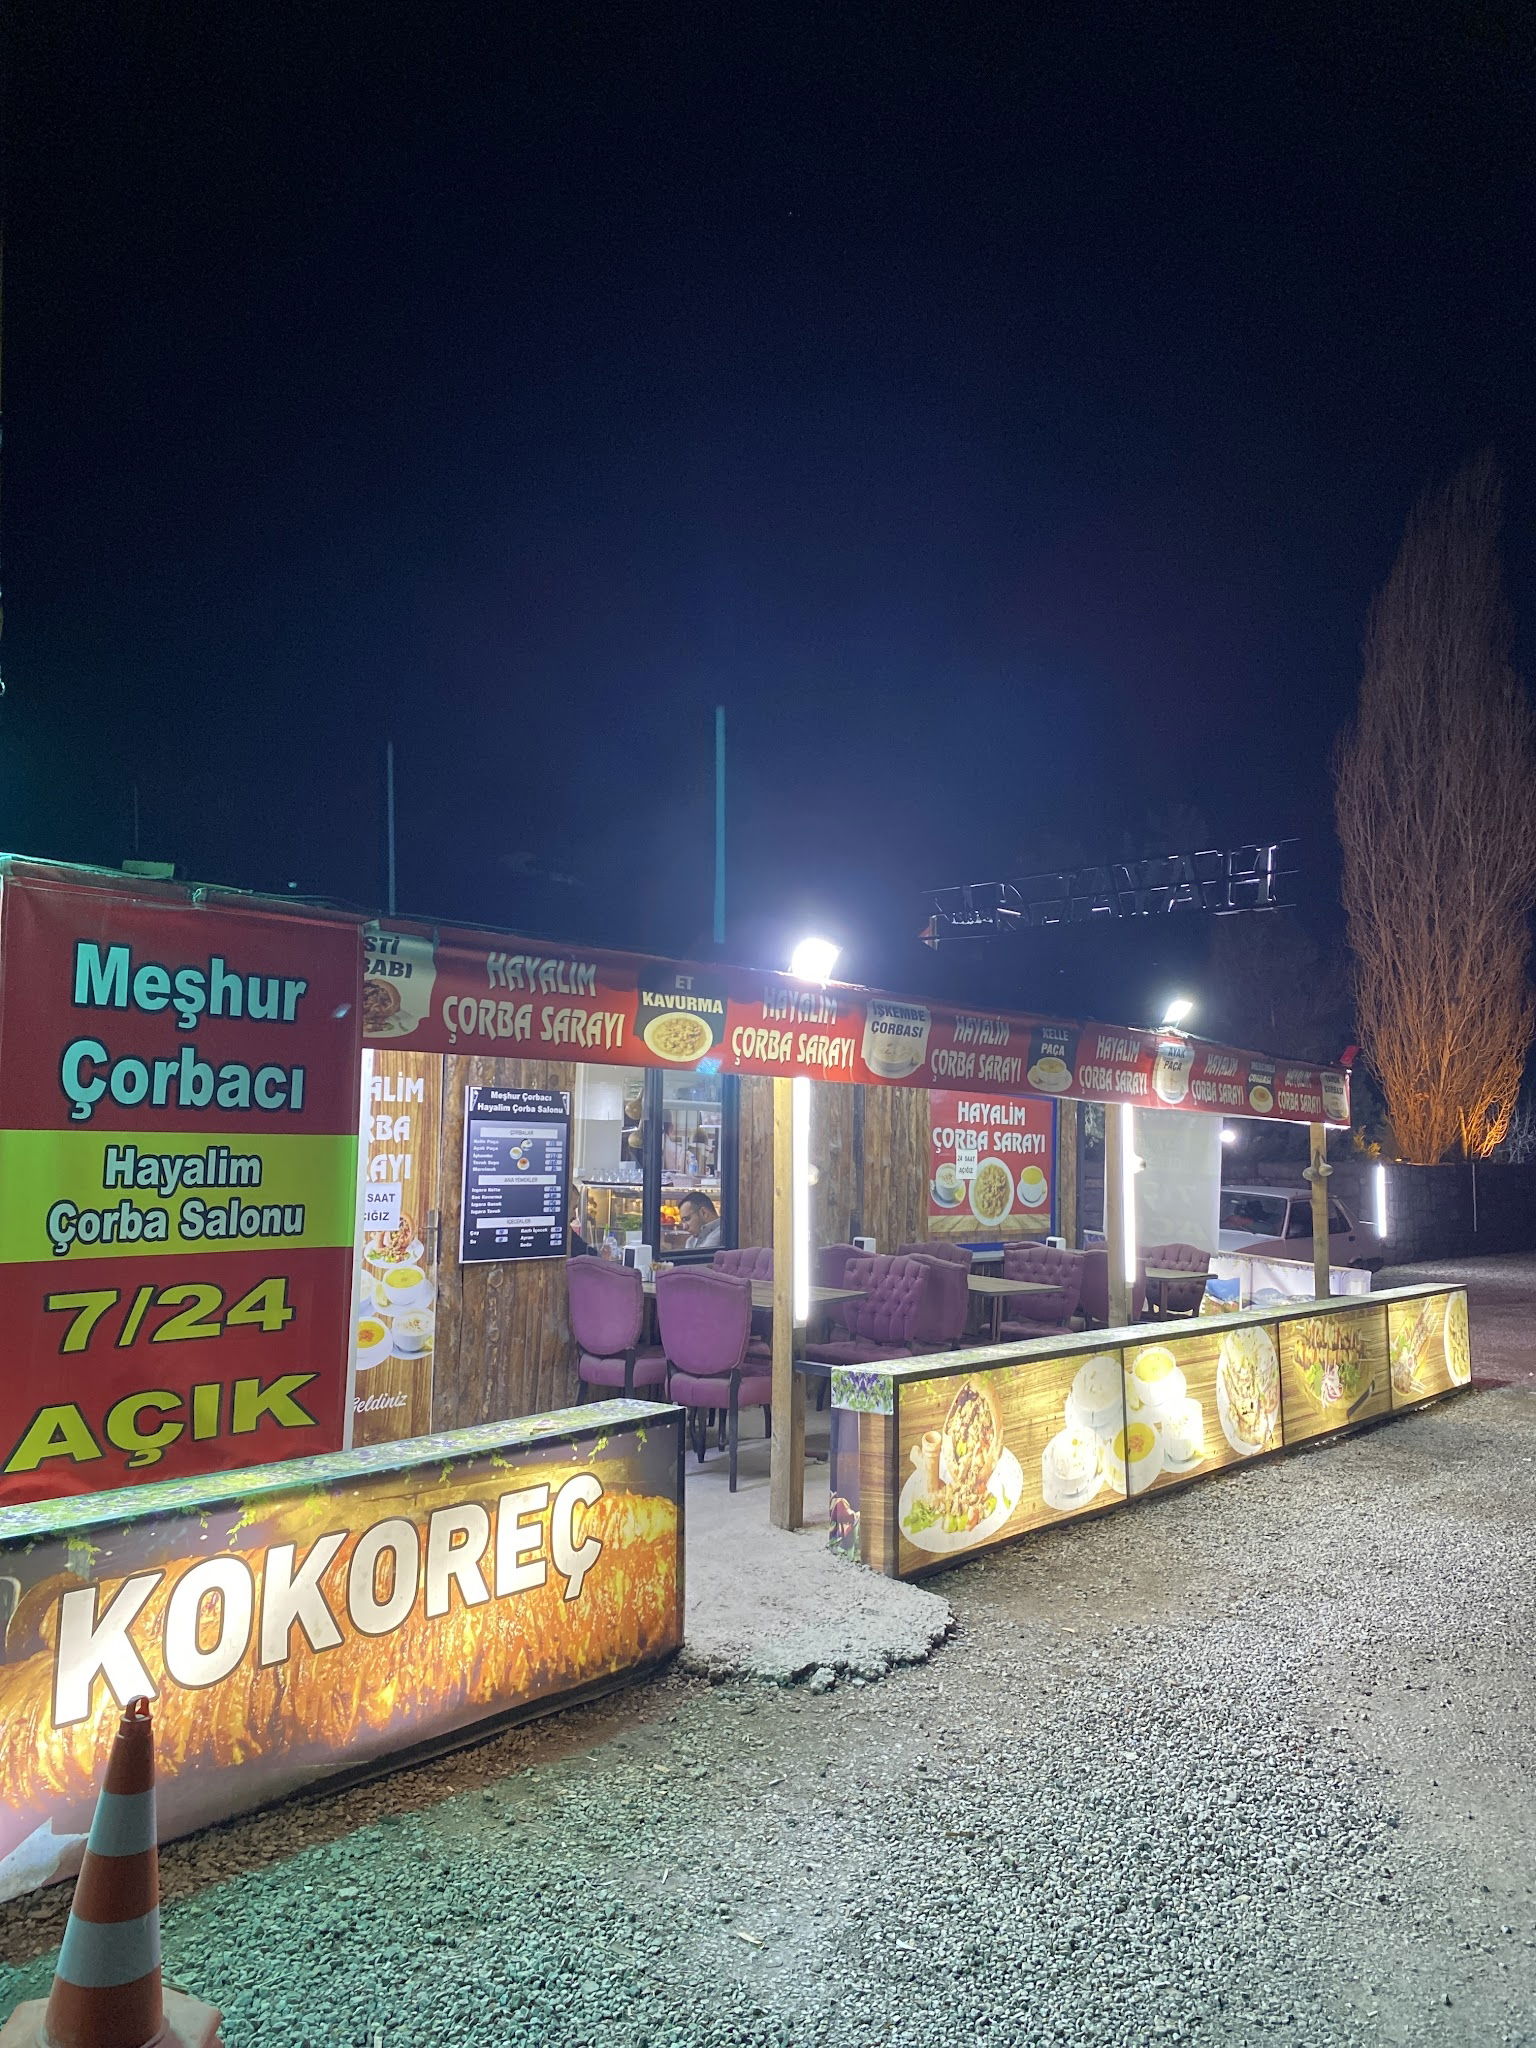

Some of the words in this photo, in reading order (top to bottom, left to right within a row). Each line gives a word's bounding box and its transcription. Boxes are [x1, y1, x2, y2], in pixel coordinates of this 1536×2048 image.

[73, 941, 306, 1029] Meşhur
[486, 952, 597, 997] HAYALİM
[675, 975, 694, 990] ET
[643, 991, 723, 1014] KAVURMA
[873, 1000, 926, 1022] İŞKEMBE
[443, 996, 533, 1044] ÇORBA
[540, 1006, 626, 1050] SARAYI
[871, 1021, 924, 1038] ÇORBASI
[953, 1015, 1010, 1046] HAYALİM
[1042, 1027, 1069, 1041] KELLE
[732, 1026, 793, 1066] ÇORBA
[797, 1033, 856, 1069] SARAYI
[1041, 1042, 1065, 1056] PAÇA
[1096, 1035, 1140, 1063] HAYALİM
[62, 1039, 304, 1120] Çorbacı
[931, 1048, 976, 1082] ÇORBA
[978, 1053, 1022, 1084] SARAYI
[1079, 1065, 1112, 1094] ÇORBA
[1115, 1069, 1148, 1096] SARAYI
[477, 1103, 511, 1113] Hayalim
[512, 1104, 536, 1114] Çorba
[538, 1106, 563, 1114] Salonu
[490, 1091, 520, 1101] Meşhur
[522, 1093, 552, 1102] Çorbacı
[957, 1101, 1026, 1126] HAYALİM
[932, 1127, 989, 1154] ÇORBA
[993, 1131, 1046, 1154] SARAYI
[104, 1147, 262, 1195] Hayalim
[367, 1153, 412, 1183] AYI
[367, 1193, 396, 1203] SAAT
[47, 1201, 168, 1254] Çorba
[180, 1200, 304, 1239] Salonu
[364, 1210, 390, 1221] IĞIZ
[47, 1277, 294, 1353] 7/24
[3, 1373, 319, 1474] AÇIK
[52, 1473, 604, 1730] KOKOREÇ
